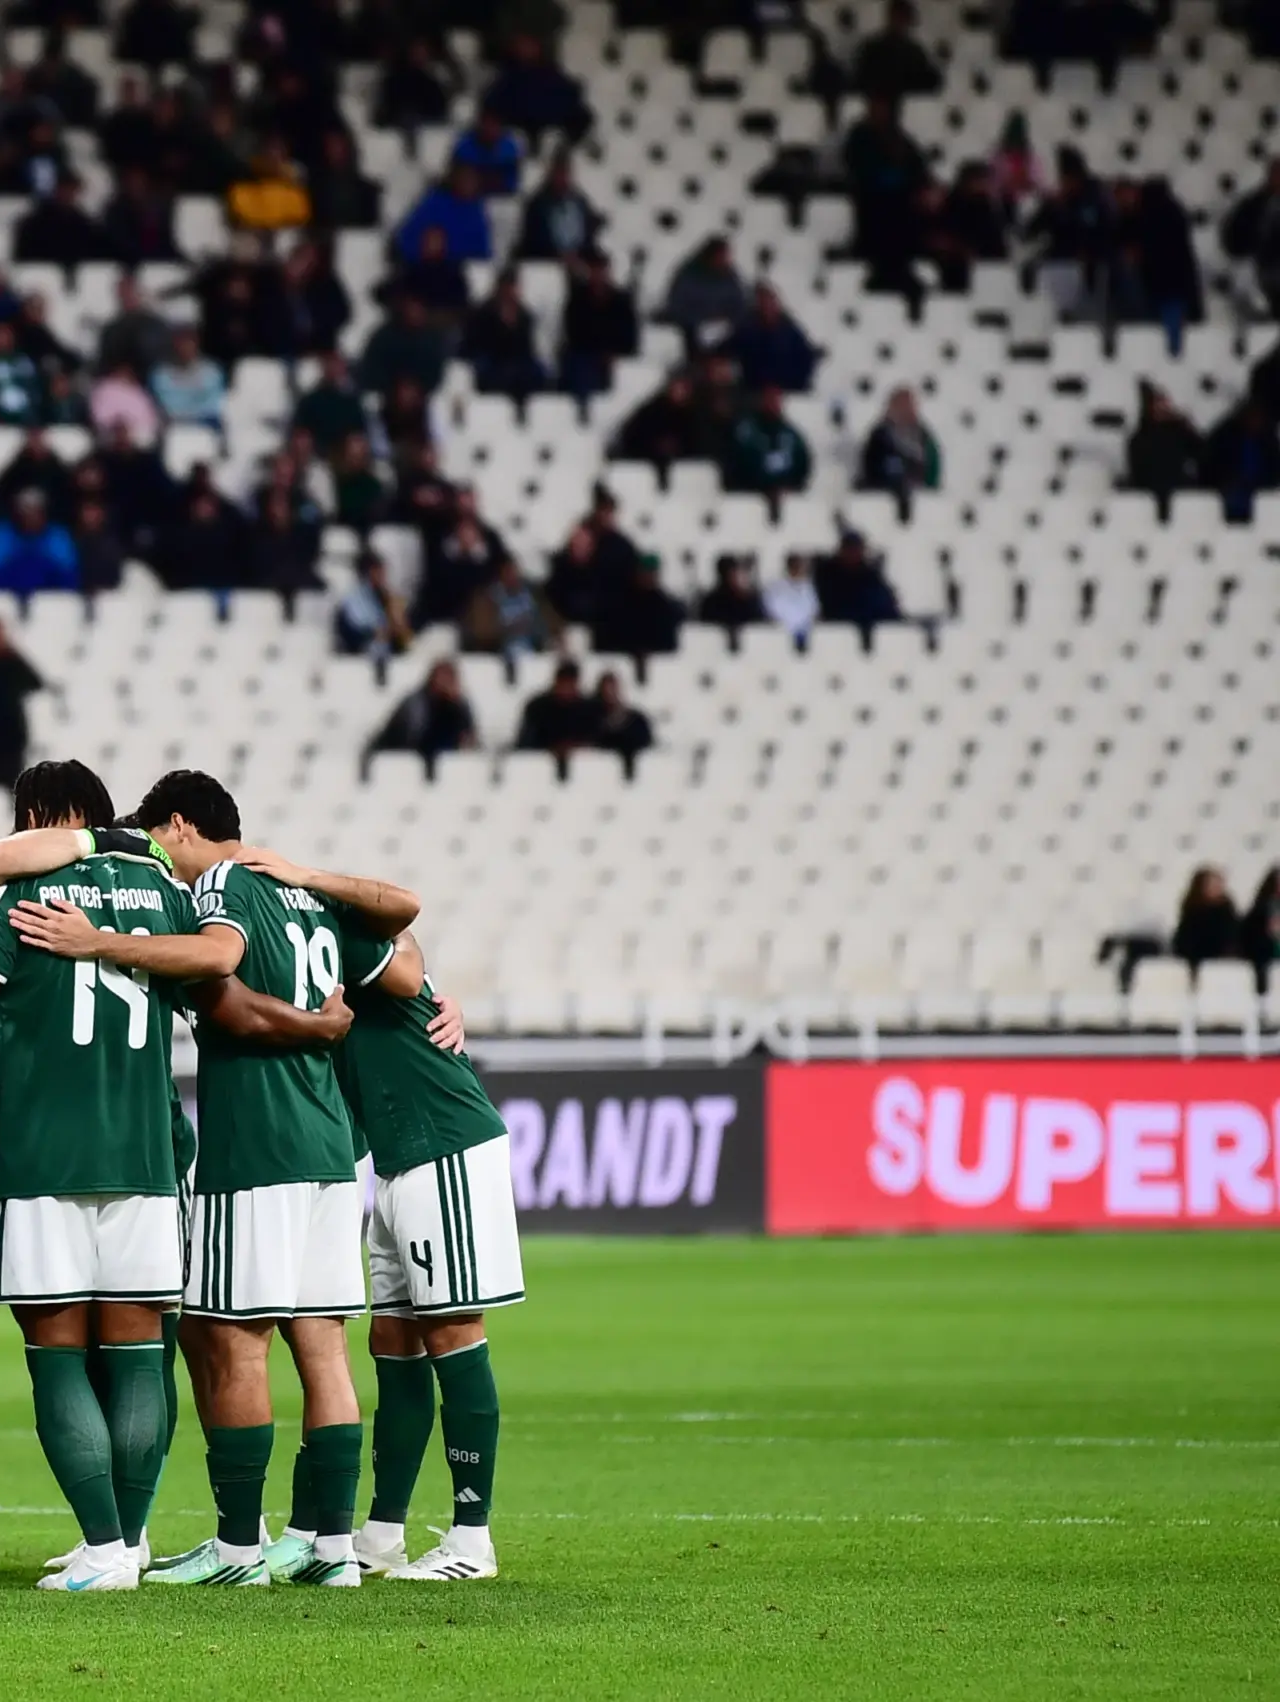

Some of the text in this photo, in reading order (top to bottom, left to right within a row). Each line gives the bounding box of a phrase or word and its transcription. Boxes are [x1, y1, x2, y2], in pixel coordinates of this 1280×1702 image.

[866, 1076, 1280, 1216] SUPER
[410, 1239, 433, 1287] 4
[448, 1446, 480, 1464] 1908
